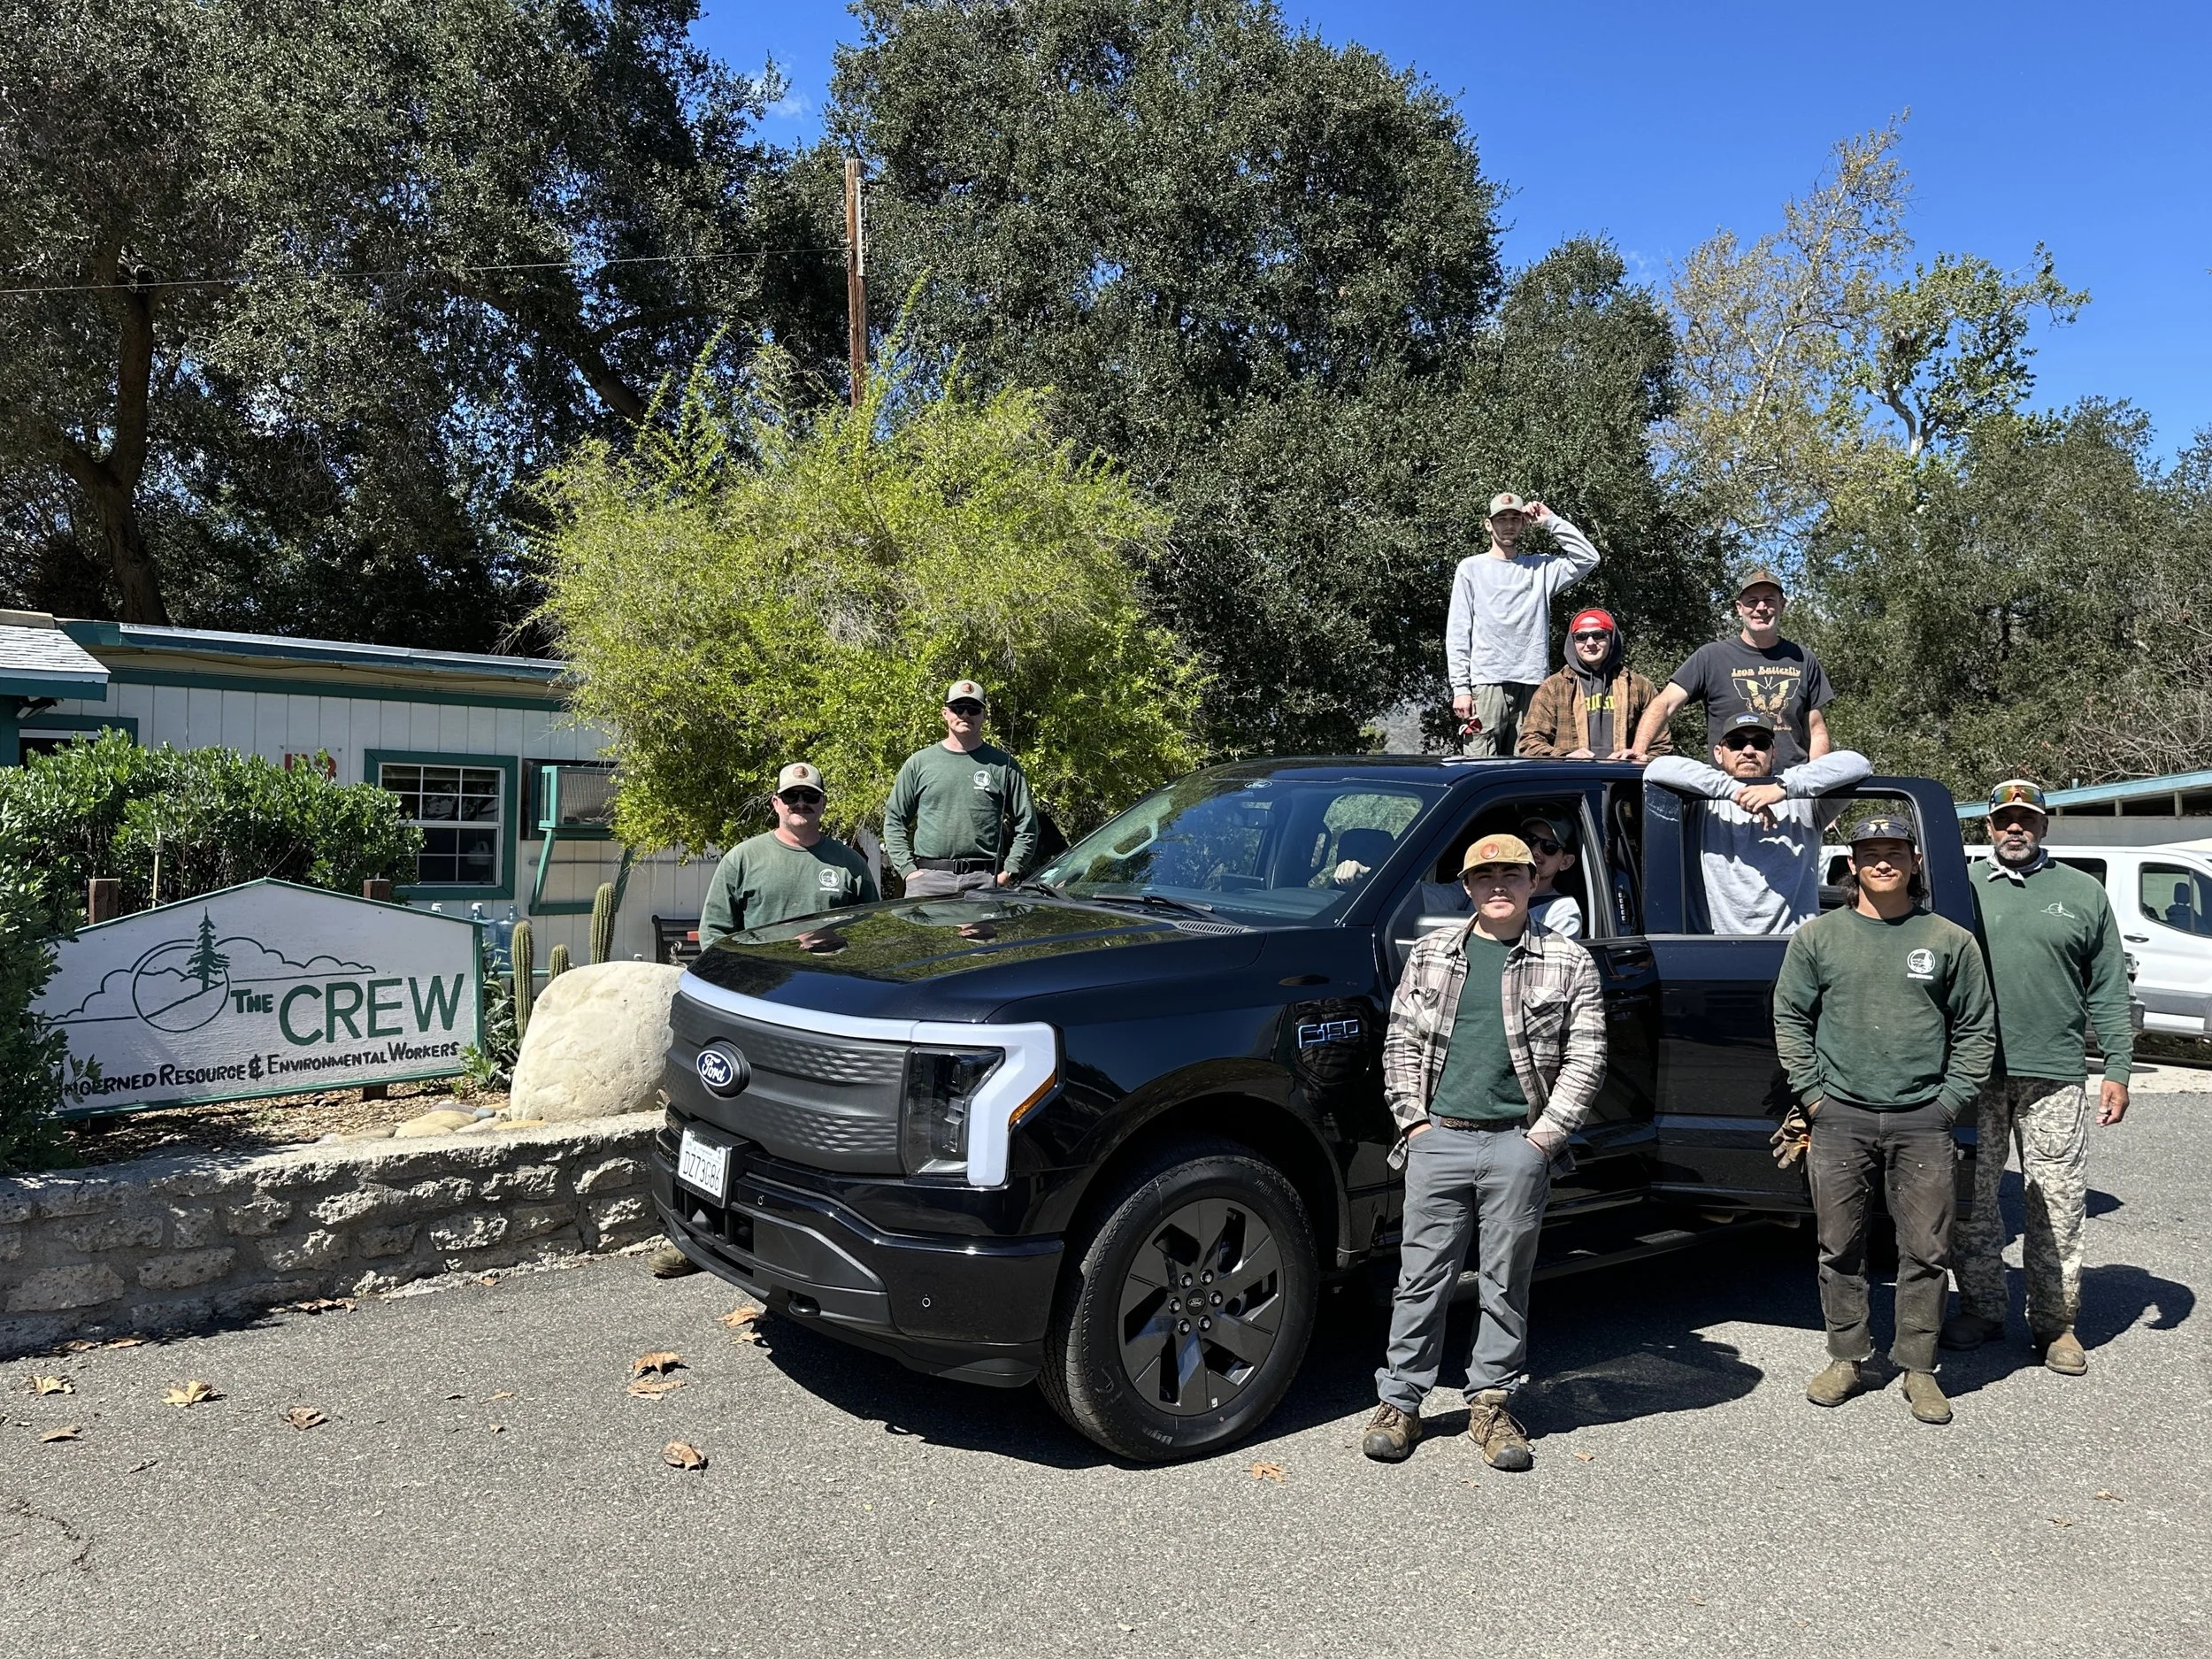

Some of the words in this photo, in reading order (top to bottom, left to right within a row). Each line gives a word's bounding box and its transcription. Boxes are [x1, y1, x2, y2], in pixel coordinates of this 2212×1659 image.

[1731, 667, 1755, 678] Iron
[1757, 665, 1801, 677] Butterfly
[230, 988, 273, 1014] THE
[279, 973, 465, 1046] CREW
[159, 1064, 247, 1087] RESOURCE
[267, 1054, 388, 1074] ENVIRONMENTAL
[388, 1041, 460, 1062] WORKERS
[702, 1054, 726, 1082] Ford
[682, 1150, 722, 1191] DZ73G86
